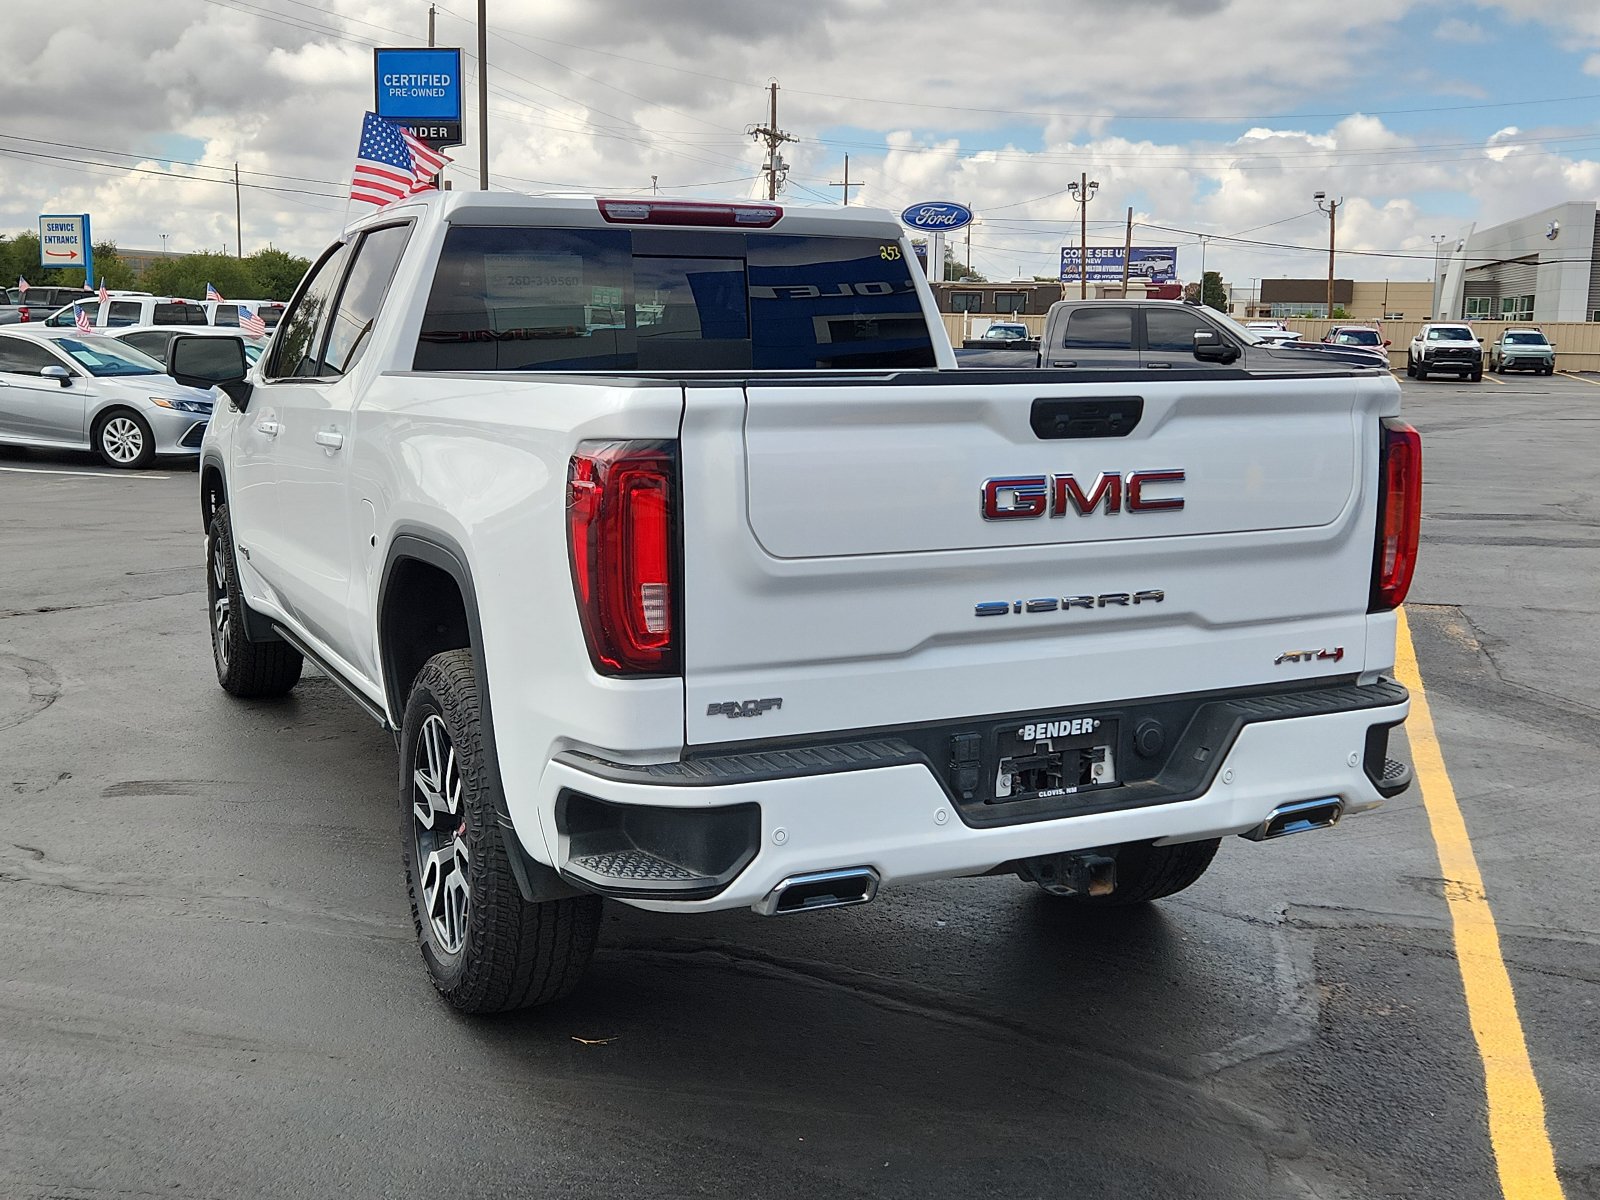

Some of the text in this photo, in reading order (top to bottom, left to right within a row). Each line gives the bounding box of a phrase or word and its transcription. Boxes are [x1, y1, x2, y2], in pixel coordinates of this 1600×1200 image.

[383, 74, 451, 86] CERTIFIED
[389, 88, 446, 97] PRE-OWNED
[408, 127, 448, 138] NDER
[915, 206, 958, 225] Ford
[46, 223, 75, 232] SERVICE
[44, 235, 78, 244] ENTRANCE
[879, 246, 901, 261] 253
[1094, 249, 1114, 259] SEE
[980, 468, 1185, 522] GMC
[974, 589, 1165, 617] SIERRA
[1273, 646, 1344, 665] AT4
[706, 697, 783, 716] BENDER
[1023, 718, 1094, 741] BENDER
[1038, 788, 1066, 798] CLOVIS,
